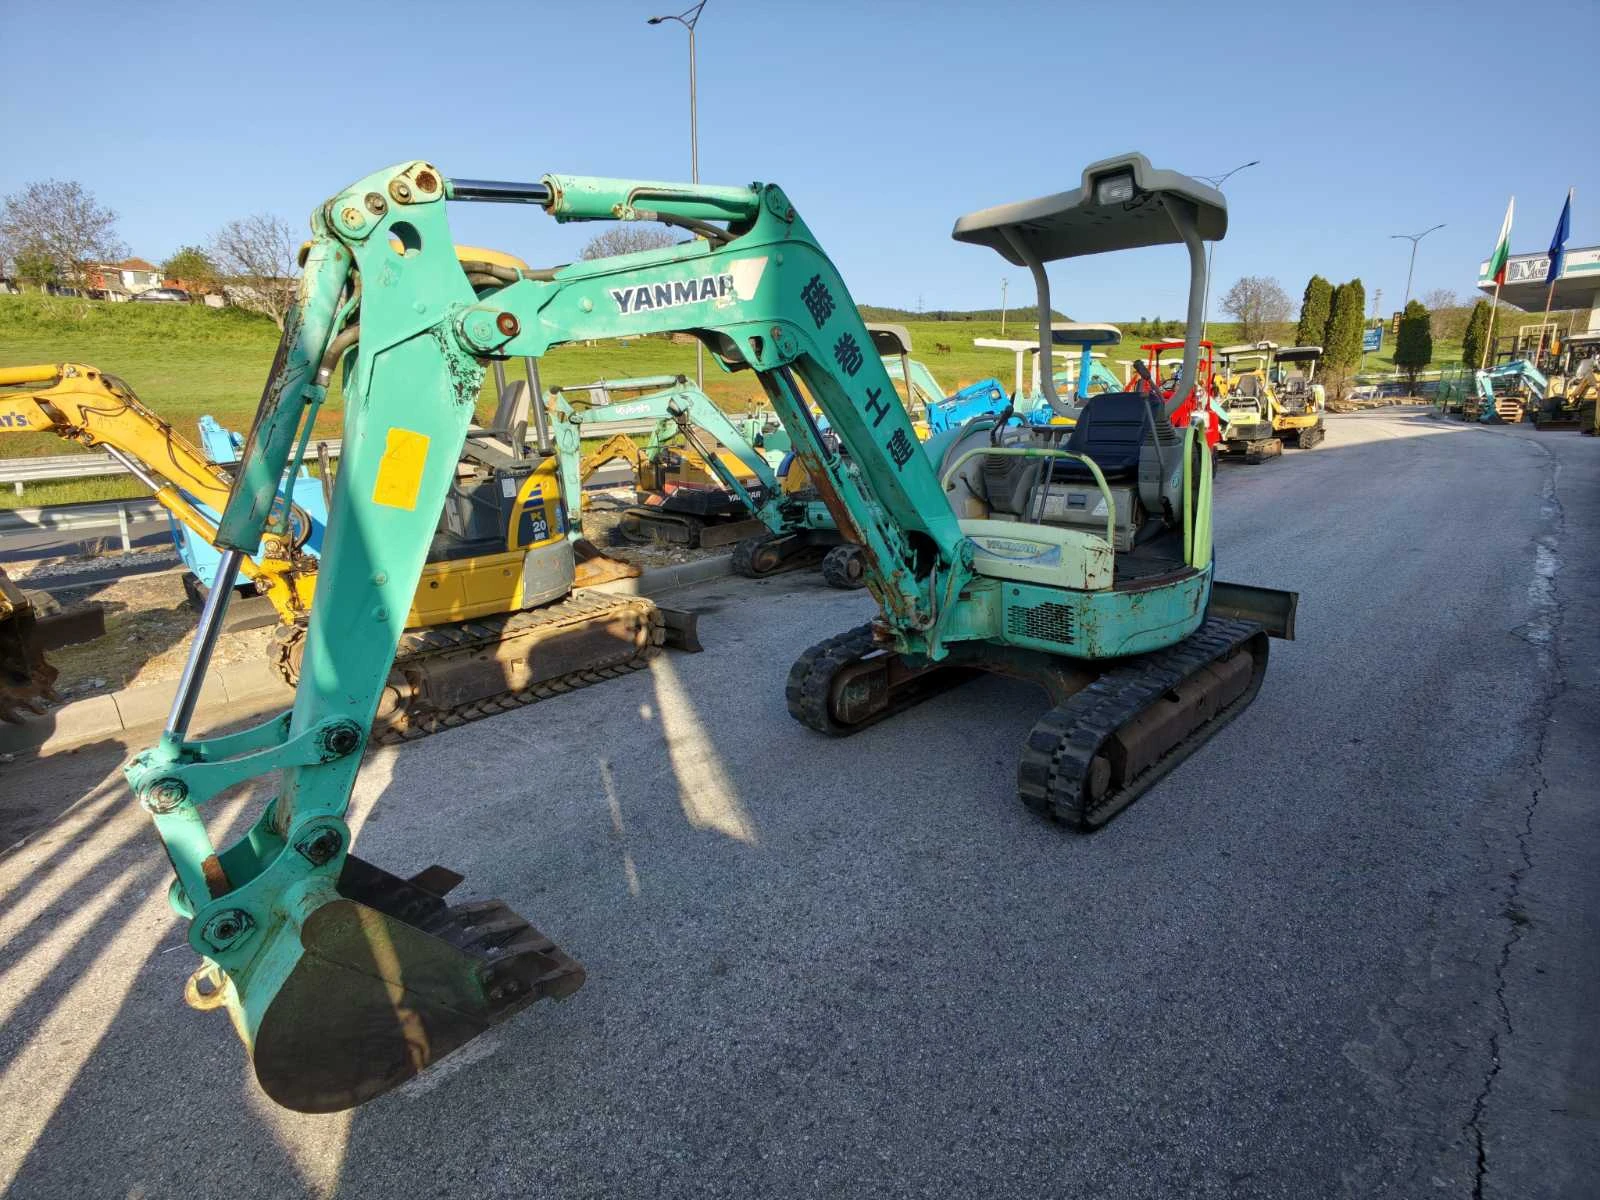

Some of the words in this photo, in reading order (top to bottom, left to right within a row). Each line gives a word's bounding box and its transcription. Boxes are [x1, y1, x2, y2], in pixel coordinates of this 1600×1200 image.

[611, 274, 736, 314] YANMAR
[801, 274, 914, 472] 藤巻土建
[532, 520, 546, 532] 20
